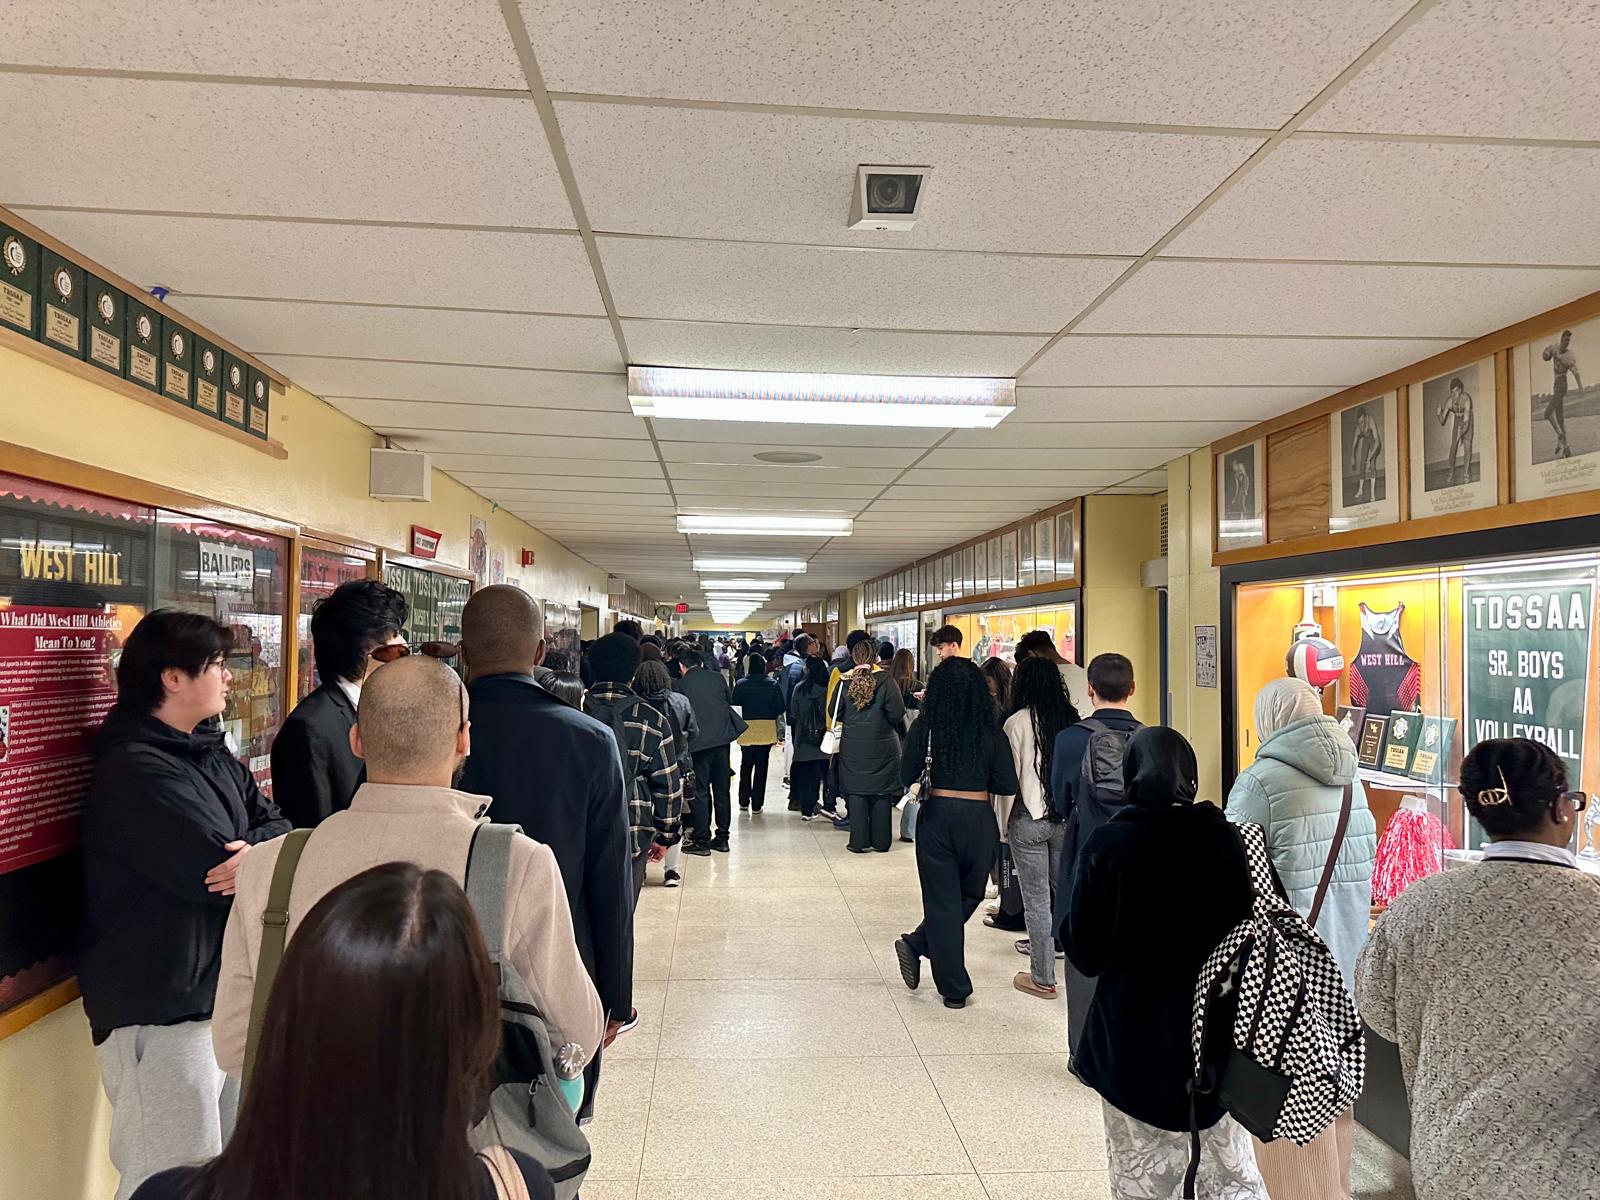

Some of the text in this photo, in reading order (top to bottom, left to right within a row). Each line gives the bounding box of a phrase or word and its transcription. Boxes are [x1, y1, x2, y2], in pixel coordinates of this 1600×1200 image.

[20, 541, 122, 586] WEST HILL
[0, 612, 122, 628] What Did West Hill Athletics
[1471, 592, 1586, 631] TDSSAA
[35, 636, 95, 649] Mean To You?
[1360, 653, 1405, 667] WEST HILL
[1489, 650, 1564, 680] SR. BOYS
[1513, 687, 1534, 715] AA
